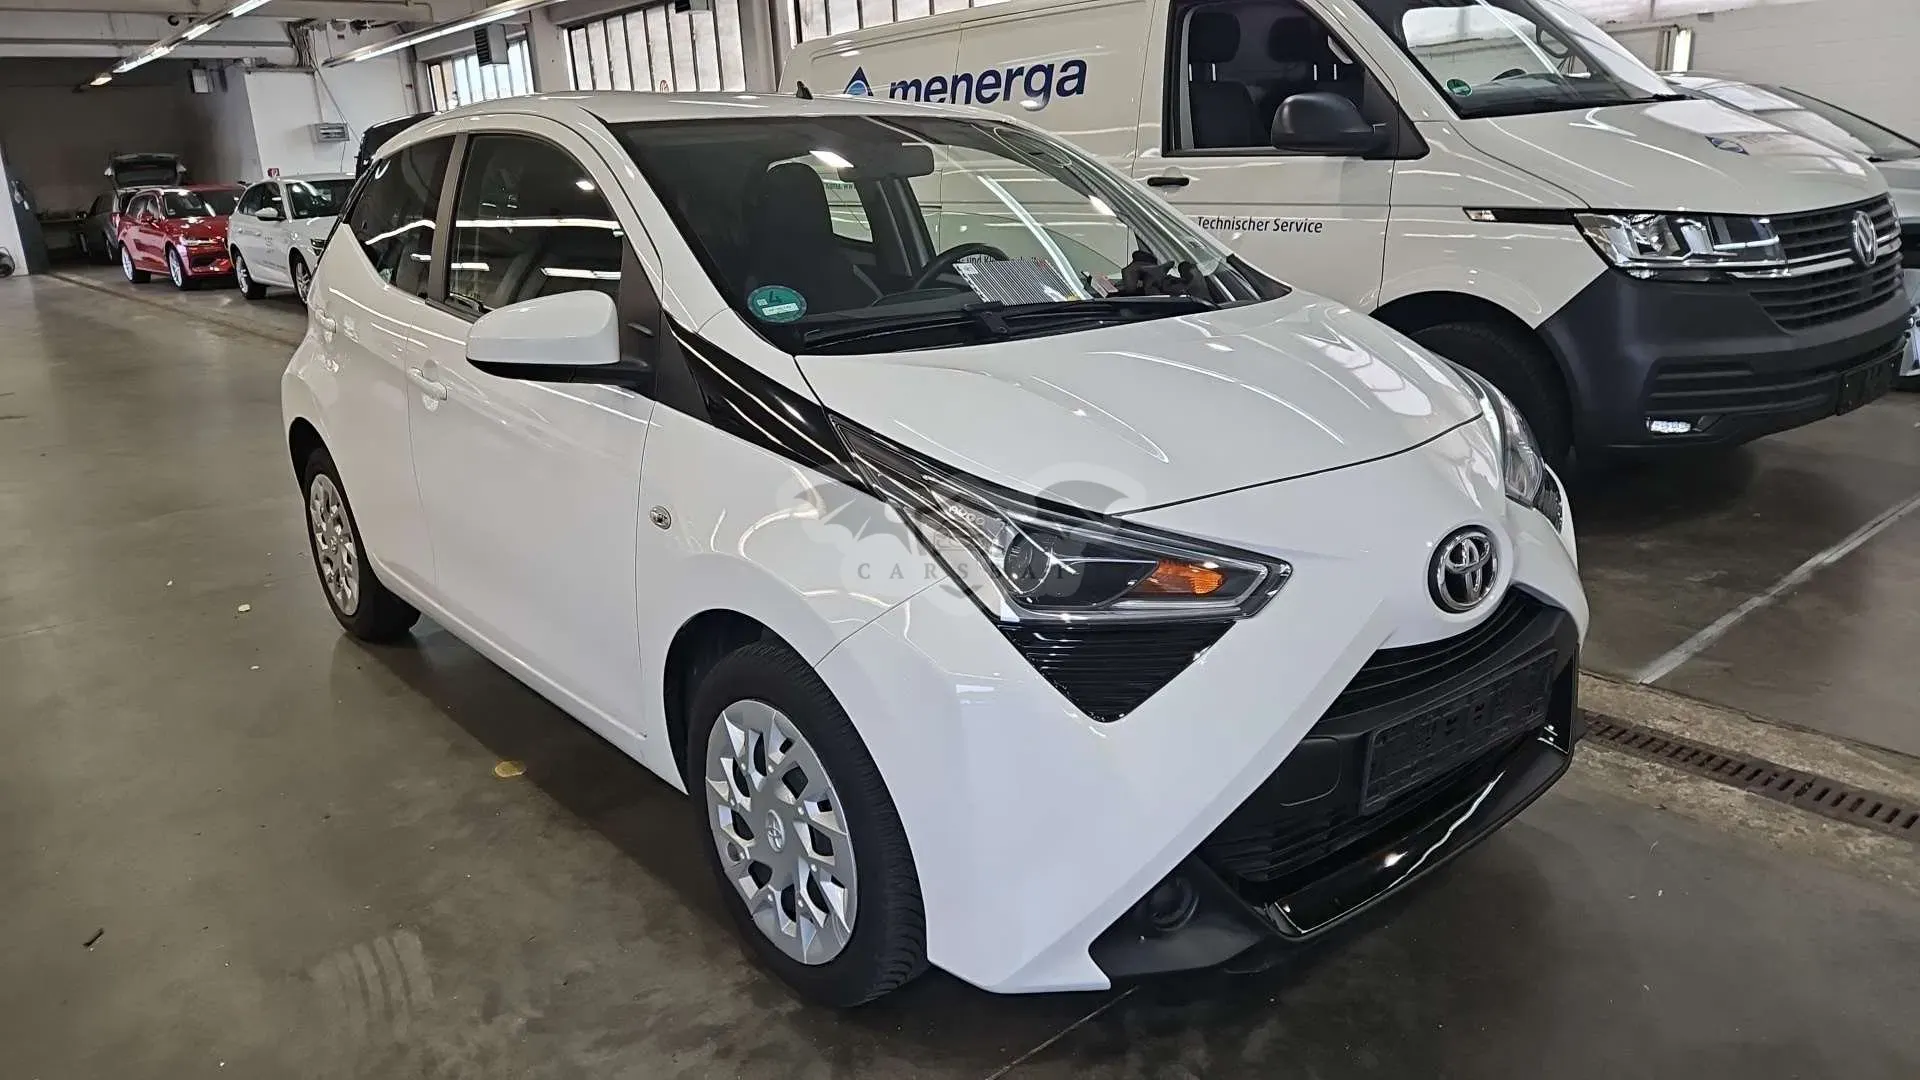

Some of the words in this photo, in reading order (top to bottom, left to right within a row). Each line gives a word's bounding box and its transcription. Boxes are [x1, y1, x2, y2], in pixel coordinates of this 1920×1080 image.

[889, 59, 1087, 112] menerga
[1197, 216, 1270, 232] Technischer
[1272, 218, 1323, 234] Service
